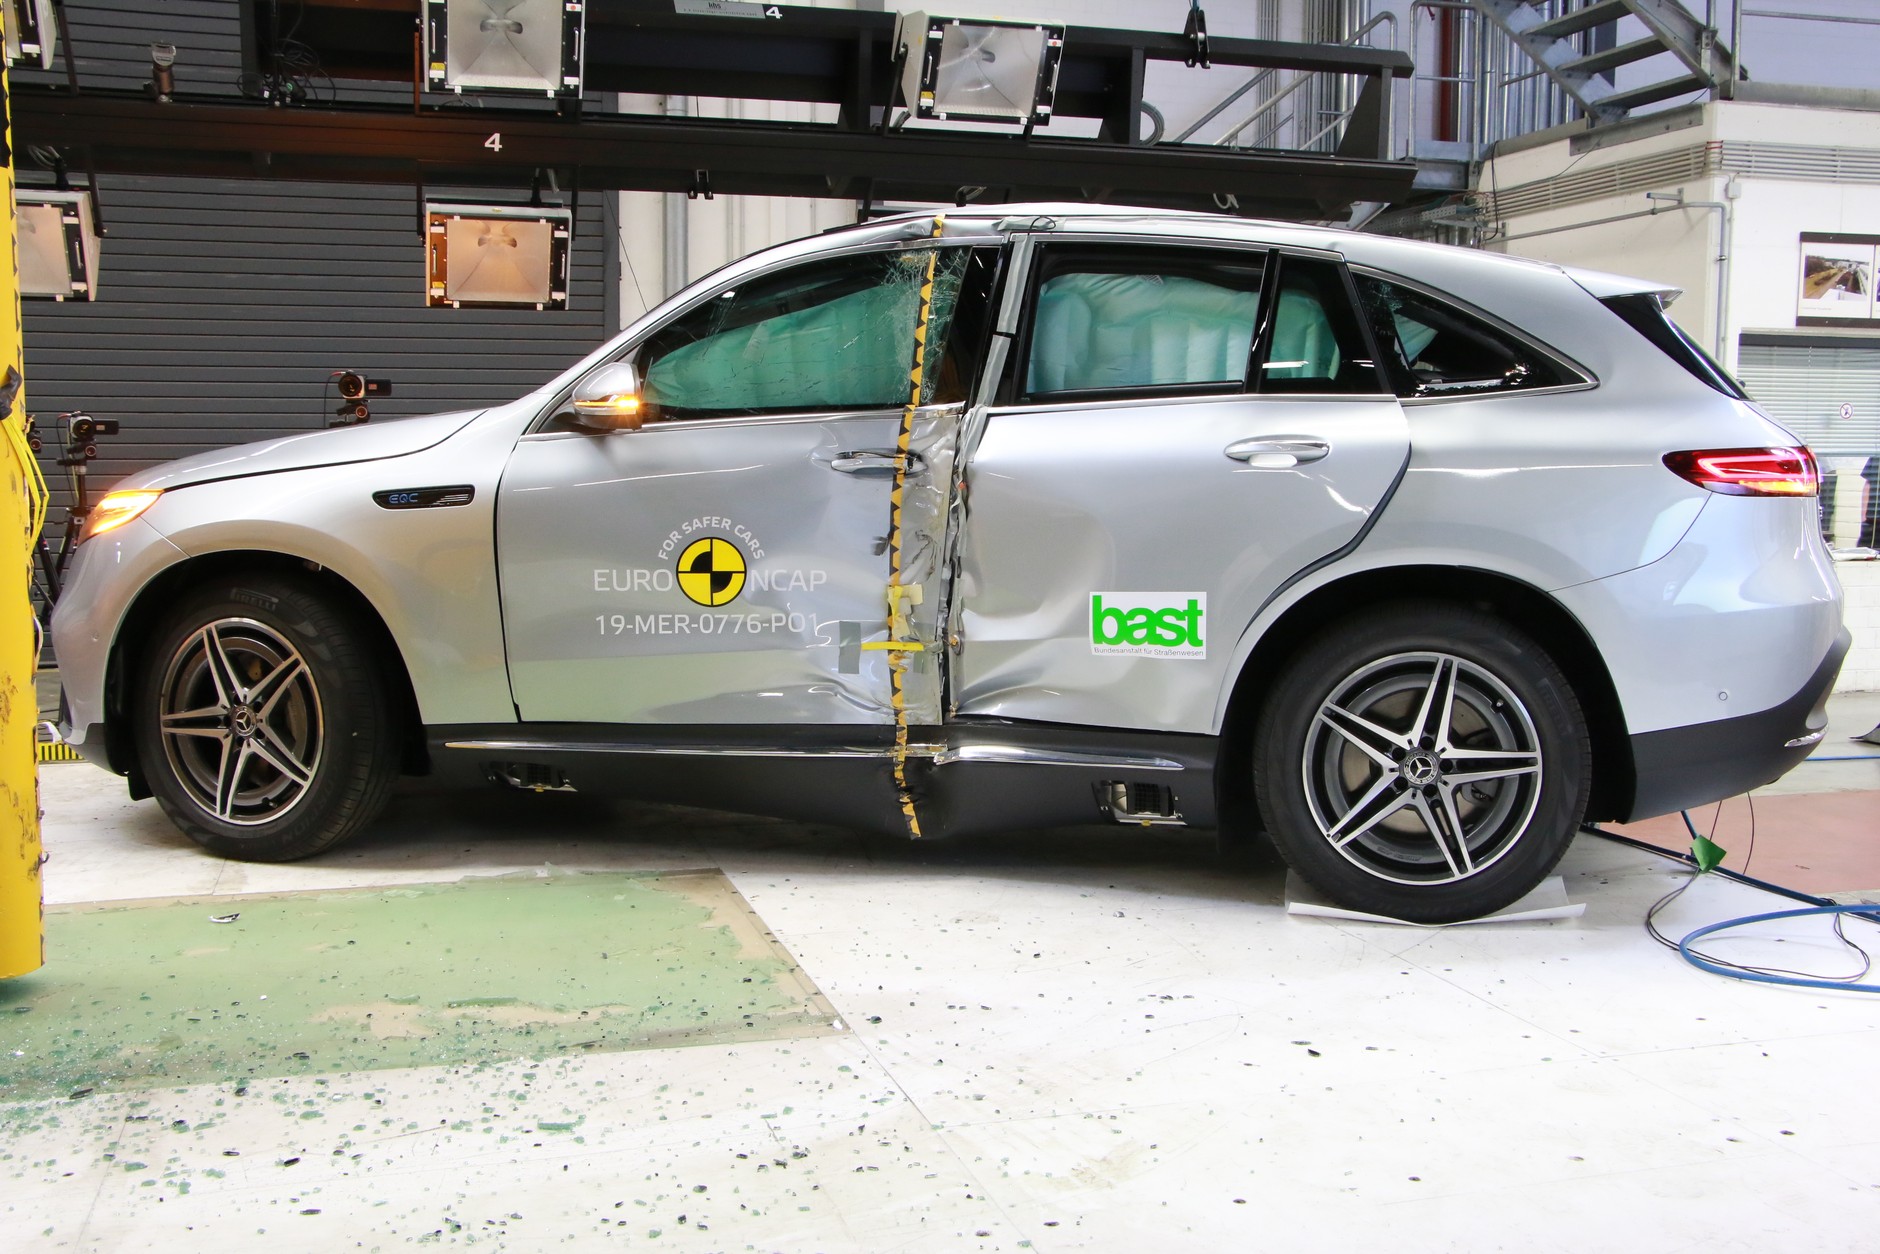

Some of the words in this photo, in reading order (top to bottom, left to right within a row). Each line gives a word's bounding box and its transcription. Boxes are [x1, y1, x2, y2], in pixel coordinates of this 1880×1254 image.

[765, 6, 783, 19] 4
[484, 132, 503, 152] 4
[388, 493, 419, 504] EQC
[658, 530, 683, 560] FOR
[681, 516, 732, 535] SAFER
[734, 524, 765, 560] CARS
[593, 568, 673, 591] EURO
[751, 569, 827, 591] NCAP
[1092, 595, 1203, 647] bast
[1153, 649, 1204, 657] Straßenwesen
